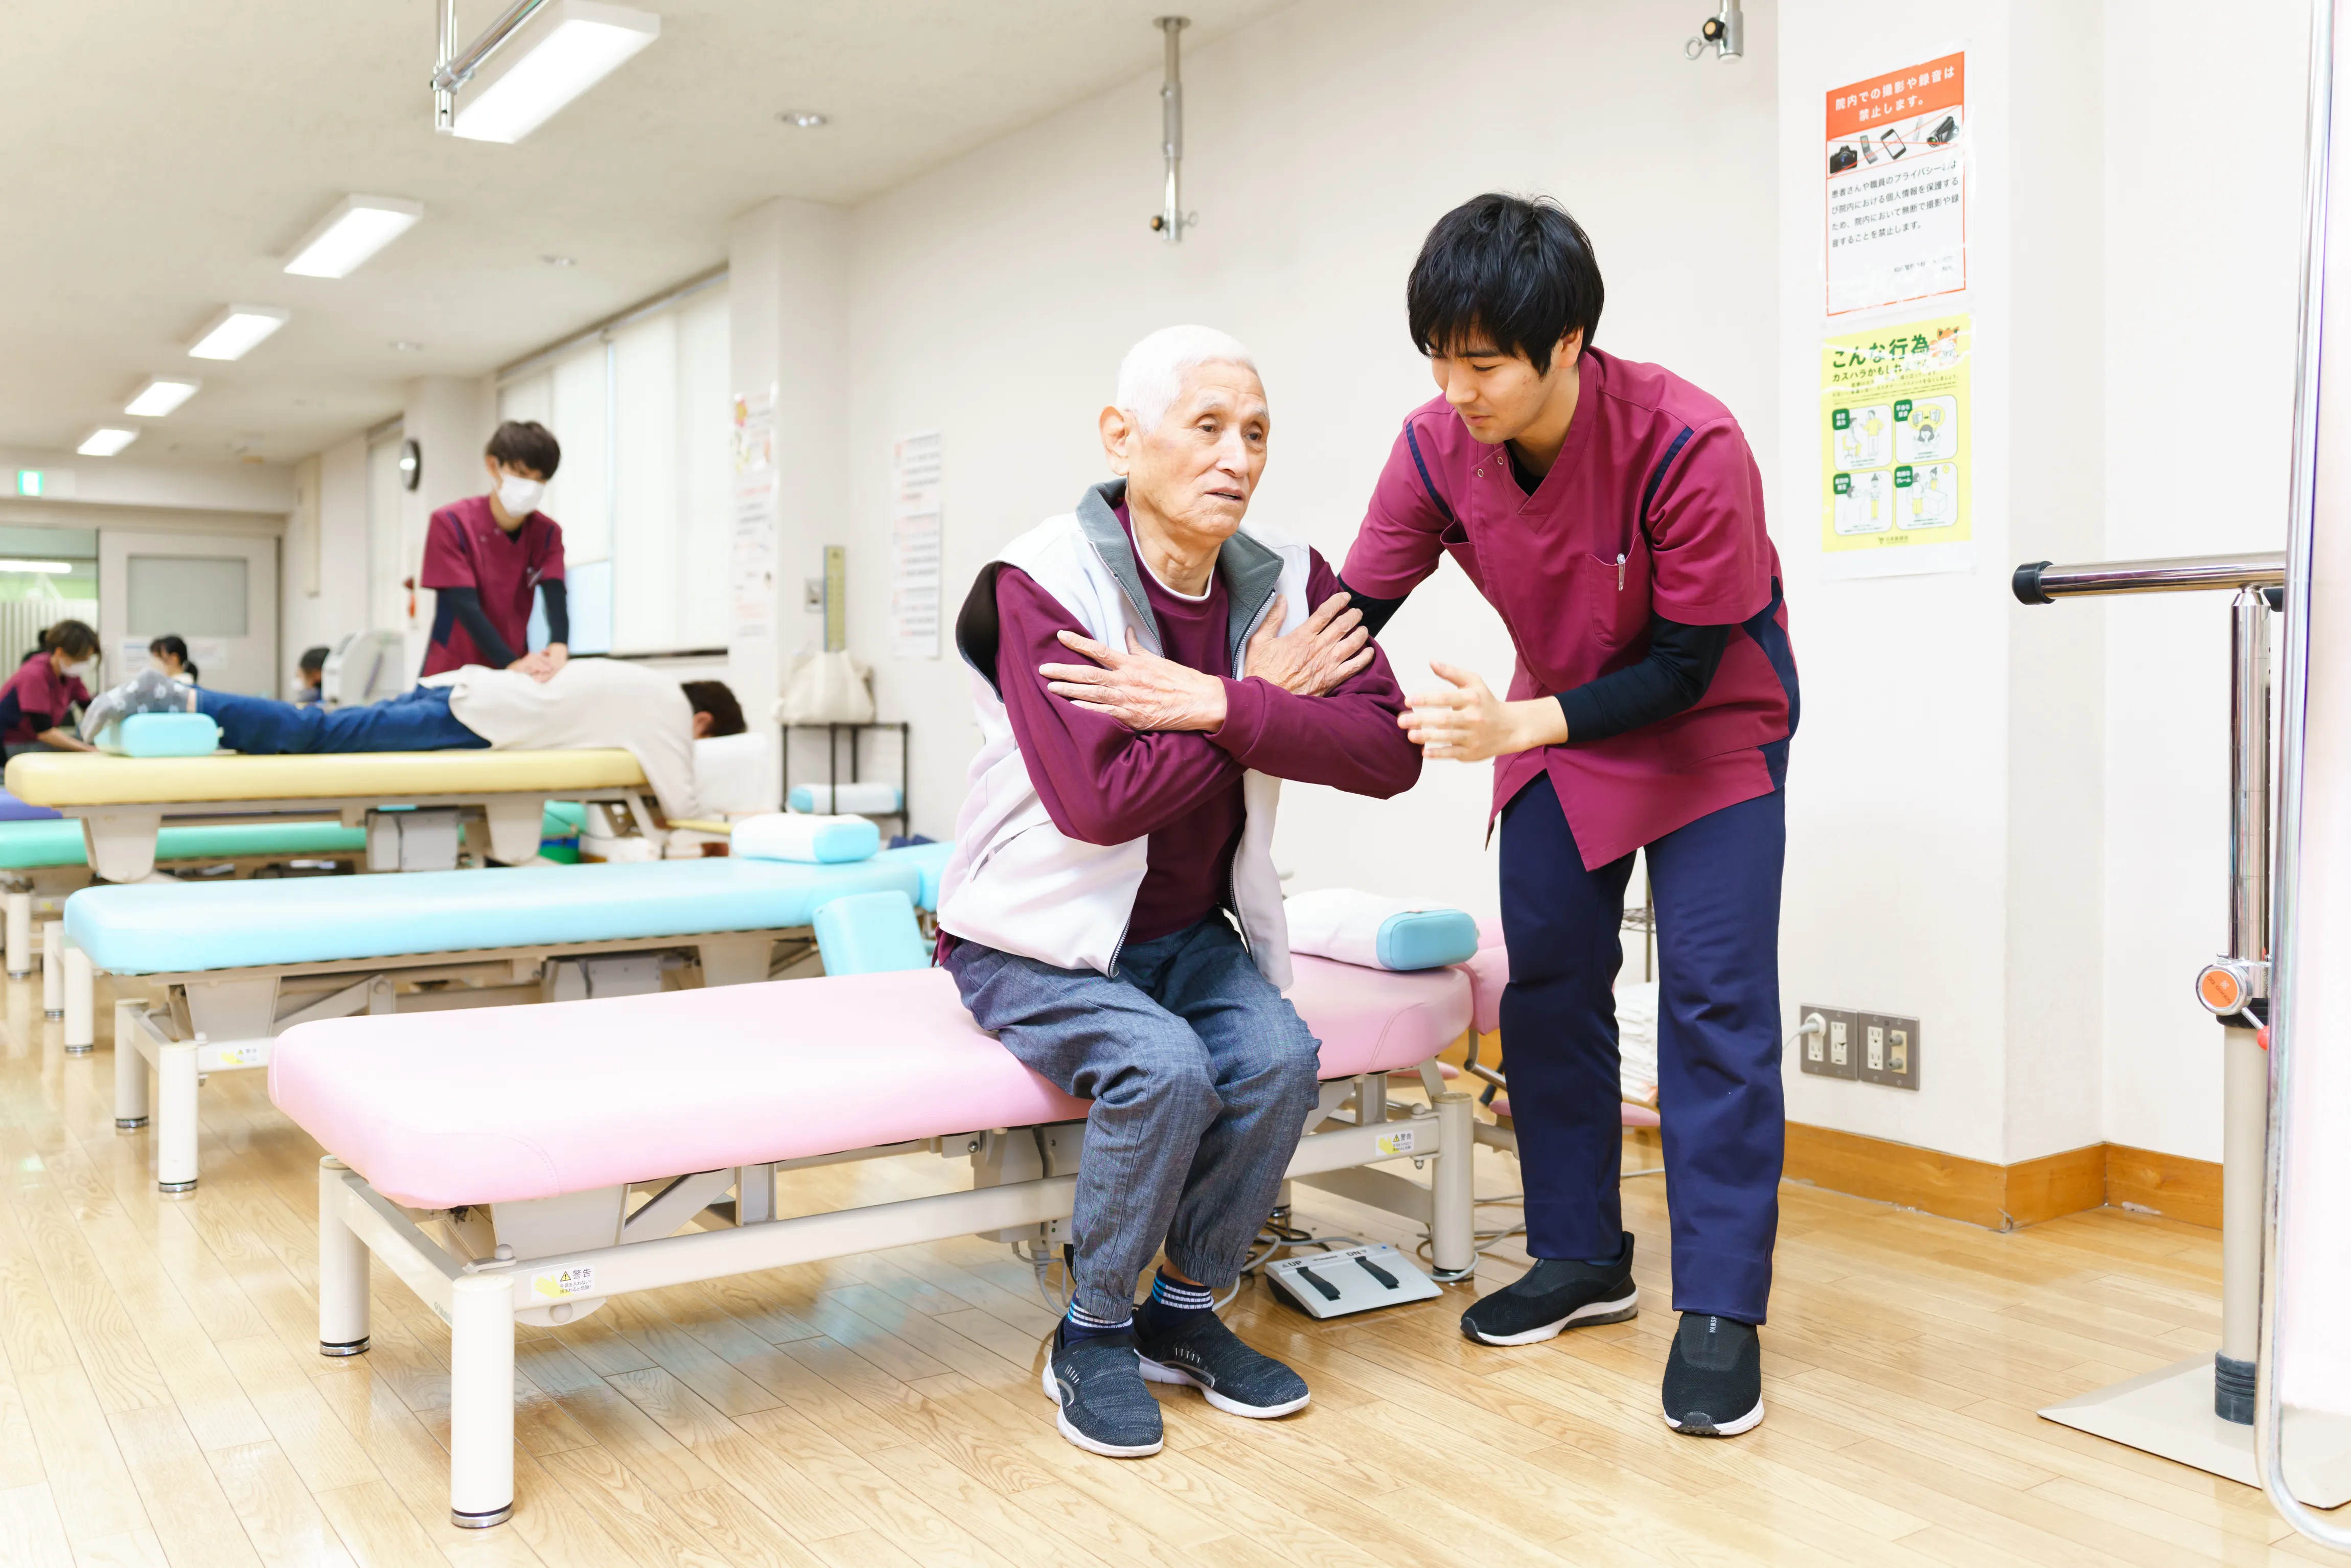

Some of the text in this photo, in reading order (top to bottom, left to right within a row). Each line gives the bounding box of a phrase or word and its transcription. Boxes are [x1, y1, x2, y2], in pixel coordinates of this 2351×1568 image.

[1835, 66, 1954, 110] 院内での撮影や録音は
[1859, 95, 1923, 122] 禁止します。
[1832, 221, 1921, 247] 音することを禁止します。
[1833, 334, 1929, 367] こんな行為
[573, 1269, 591, 1279] 警告
[1709, 1316, 1717, 1333] VANSP
